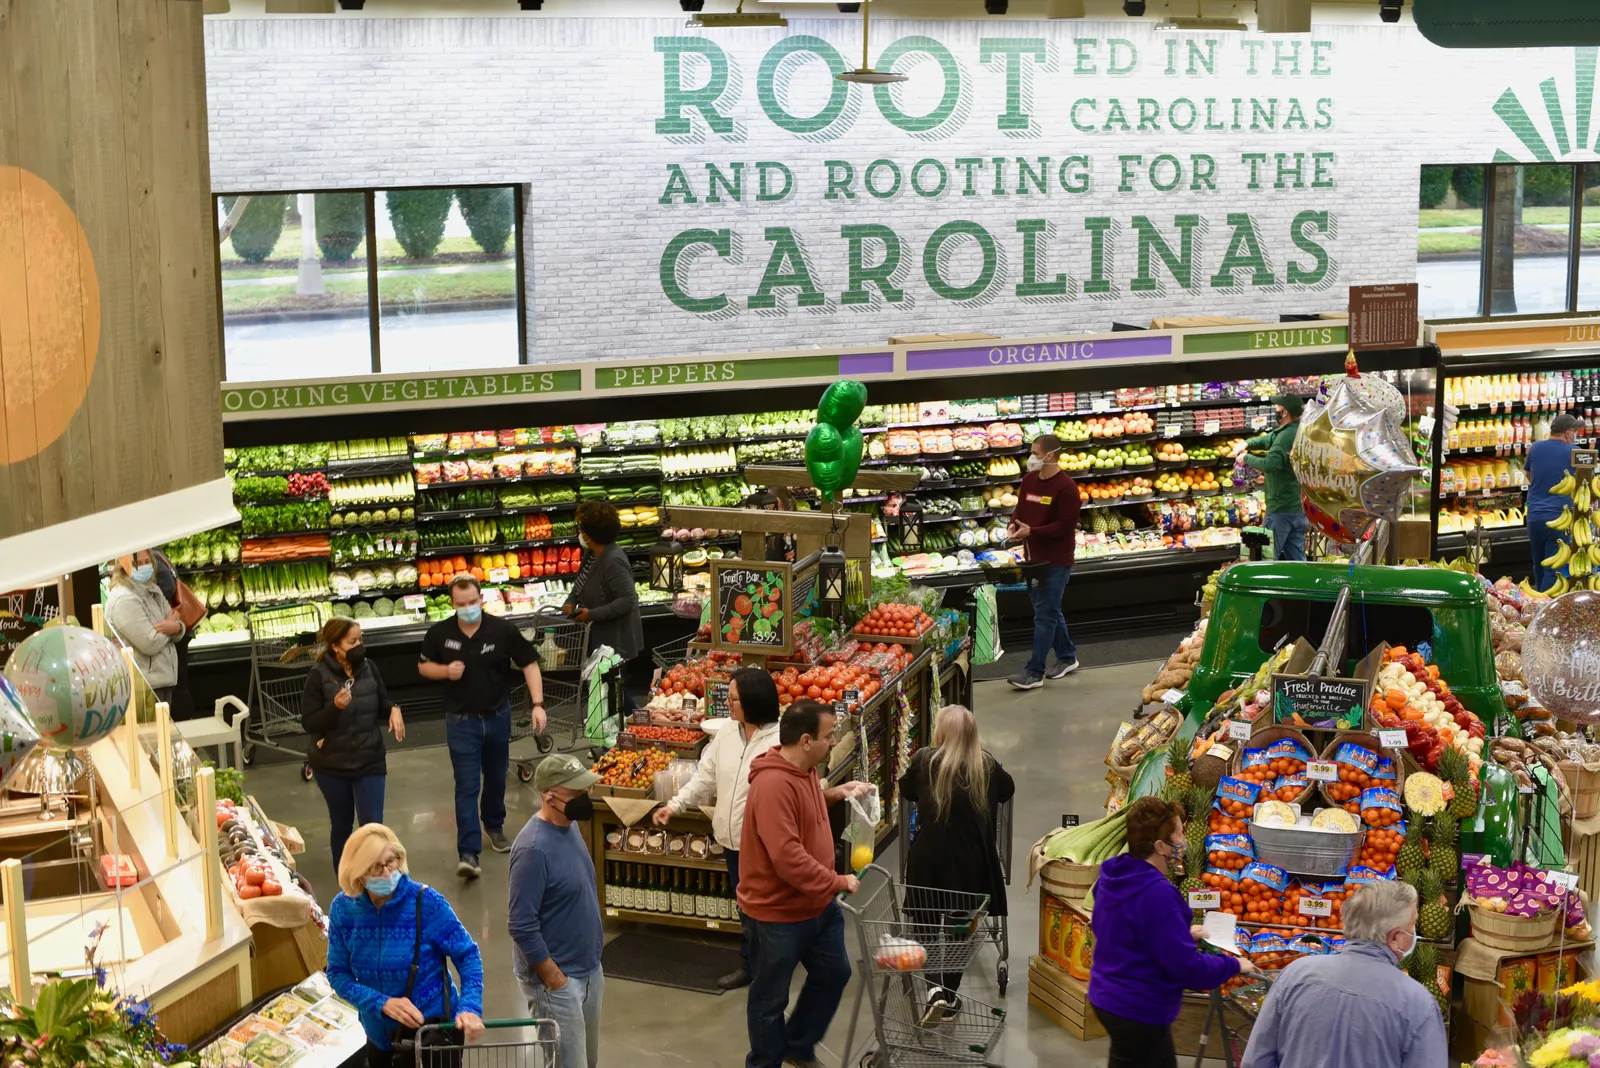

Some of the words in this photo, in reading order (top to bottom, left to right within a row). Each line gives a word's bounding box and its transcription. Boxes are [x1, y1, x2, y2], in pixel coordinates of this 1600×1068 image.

[1073, 38, 1138, 76] ED
[1164, 39, 1218, 76] IN
[1240, 40, 1333, 76] THE
[653, 35, 1050, 138] ROOT
[1070, 97, 1333, 132] CAROLINAS
[658, 161, 794, 205] AND
[823, 155, 1091, 200] ROOTING
[1117, 153, 1217, 193] FOR
[1241, 151, 1335, 190] THE
[659, 209, 1333, 314] CAROLINAS
[1254, 327, 1333, 349] FRUITS
[988, 341, 1095, 365] ORGANIC
[613, 362, 736, 386] PEPPERS
[225, 385, 349, 411] OOKING
[359, 372, 554, 402] VEGETABLES
[1283, 679, 1315, 697] Fresh
[1320, 681, 1357, 697] Produce
[1314, 764, 1330, 773] 3.99
[1222, 781, 1252, 799] halos
[1196, 893, 1213, 901] 2.99
[1307, 899, 1324, 908] 3.99
